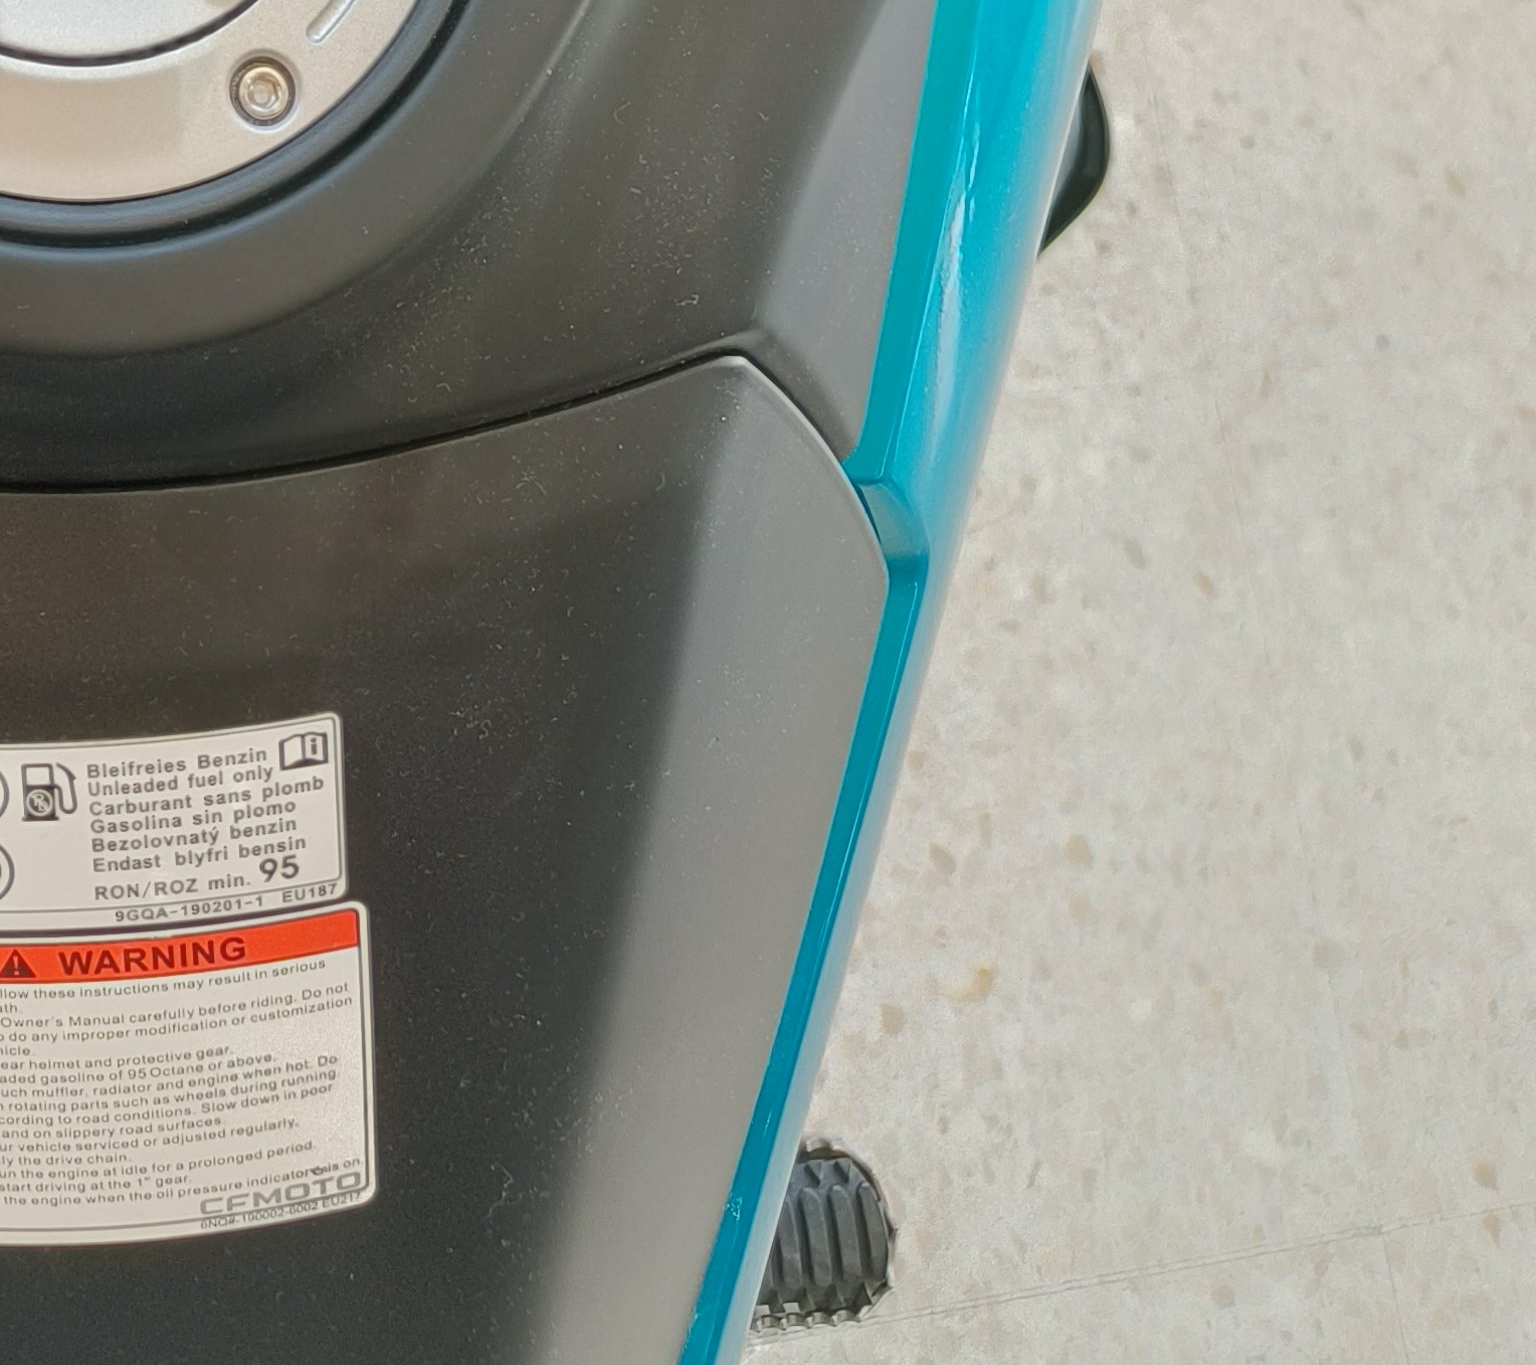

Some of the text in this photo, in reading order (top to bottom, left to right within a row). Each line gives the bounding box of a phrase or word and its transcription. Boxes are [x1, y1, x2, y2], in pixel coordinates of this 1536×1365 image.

[86, 748, 268, 779] Bleifreies Benzin
[87, 764, 274, 797] Unleaded fuel only
[89, 775, 325, 816] Carburant sans plomb
[90, 799, 296, 834] Gasolina sin plomo
[91, 818, 297, 853] Bezolovnatý benzin
[93, 836, 307, 872] Endast blyfri bensin
[94, 854, 300, 901] RON/ROZ min. 95
[115, 882, 338, 922] 9GQA-190201-1 EU187
[58, 936, 247, 977] WARNING
[32, 988, 76, 999] these
[79, 983, 169, 997] instructions
[172, 979, 204, 990] may
[208, 971, 251, 986] result
[254, 969, 268, 980] in
[271, 960, 326, 977] serious
[0, 1016, 64, 1028] Owner's
[68, 1013, 125, 1027] Manual
[128, 1007, 195, 1024] carefully
[197, 1002, 247, 1016] before
[250, 994, 297, 1009] riding.
[301, 988, 322, 1001] Do
[325, 982, 348, 996] not
[8, 1031, 27, 1042] do
[31, 1032, 58, 1044] any
[62, 1029, 131, 1042] improper
[134, 1018, 227, 1037] modification
[230, 1016, 246, 1026] or
[249, 996, 353, 1023] customization
[28, 1059, 81, 1070] helmet
[84, 1057, 112, 1068] and
[116, 1051, 192, 1069] protective
[39, 1072, 105, 1086] gasoline
[108, 1069, 123, 1081] of
[127, 1067, 147, 1080] 95
[148, 1060, 204, 1078] Octane
[207, 1060, 223, 1071] or
[226, 1053, 277, 1069] above.
[92, 1083, 152, 1096] radiator
[155, 1078, 184, 1091] and
[187, 1072, 239, 1088] engine
[241, 1066, 282, 1080] when
[316, 1054, 338, 1067] Do
[8, 1101, 67, 1113] rotating
[70, 1100, 109, 1112] parts
[112, 1096, 149, 1108] such
[152, 1096, 170, 1105] as
[173, 1086, 226, 1103] wheels
[229, 1080, 277, 1097] during
[57, 1112, 72, 1125] to
[75, 1112, 110, 1124] road
[200, 1101, 237, 1114] Slow
[240, 1090, 280, 1108] down
[283, 1090, 297, 1101] in
[300, 1083, 333, 1099] poor
[1, 1129, 29, 1139] and
[32, 1130, 51, 1139] on
[55, 1127, 115, 1140] slippery
[119, 1123, 153, 1135] road
[17, 1141, 71, 1152] vehicle
[75, 1138, 139, 1151] serviced
[142, 1137, 157, 1147] or
[161, 1128, 226, 1146] adjusted
[229, 1117, 300, 1137] regularly.
[17, 1155, 42, 1166] the
[45, 1155, 83, 1165] drive
[20, 1168, 44, 1179] the
[47, 1168, 99, 1181] engine
[102, 1166, 117, 1177] at
[120, 1164, 148, 1175] idle
[151, 1162, 171, 1173] for
[175, 1162, 184, 1171] a
[188, 1149, 263, 1171] prolonged
[266, 1139, 317, 1160] period.
[3, 1195, 27, 1205] the
[30, 1191, 81, 1207] engine
[84, 1194, 125, 1204] when
[128, 1191, 152, 1201] the
[155, 1185, 174, 1199] oil
[177, 1181, 243, 1198] pressure
[34, 1179, 86, 1194] driving
[89, 1181, 104, 1191] at
[107, 1179, 131, 1190] the
[199, 1171, 362, 1215] CFMOTO
